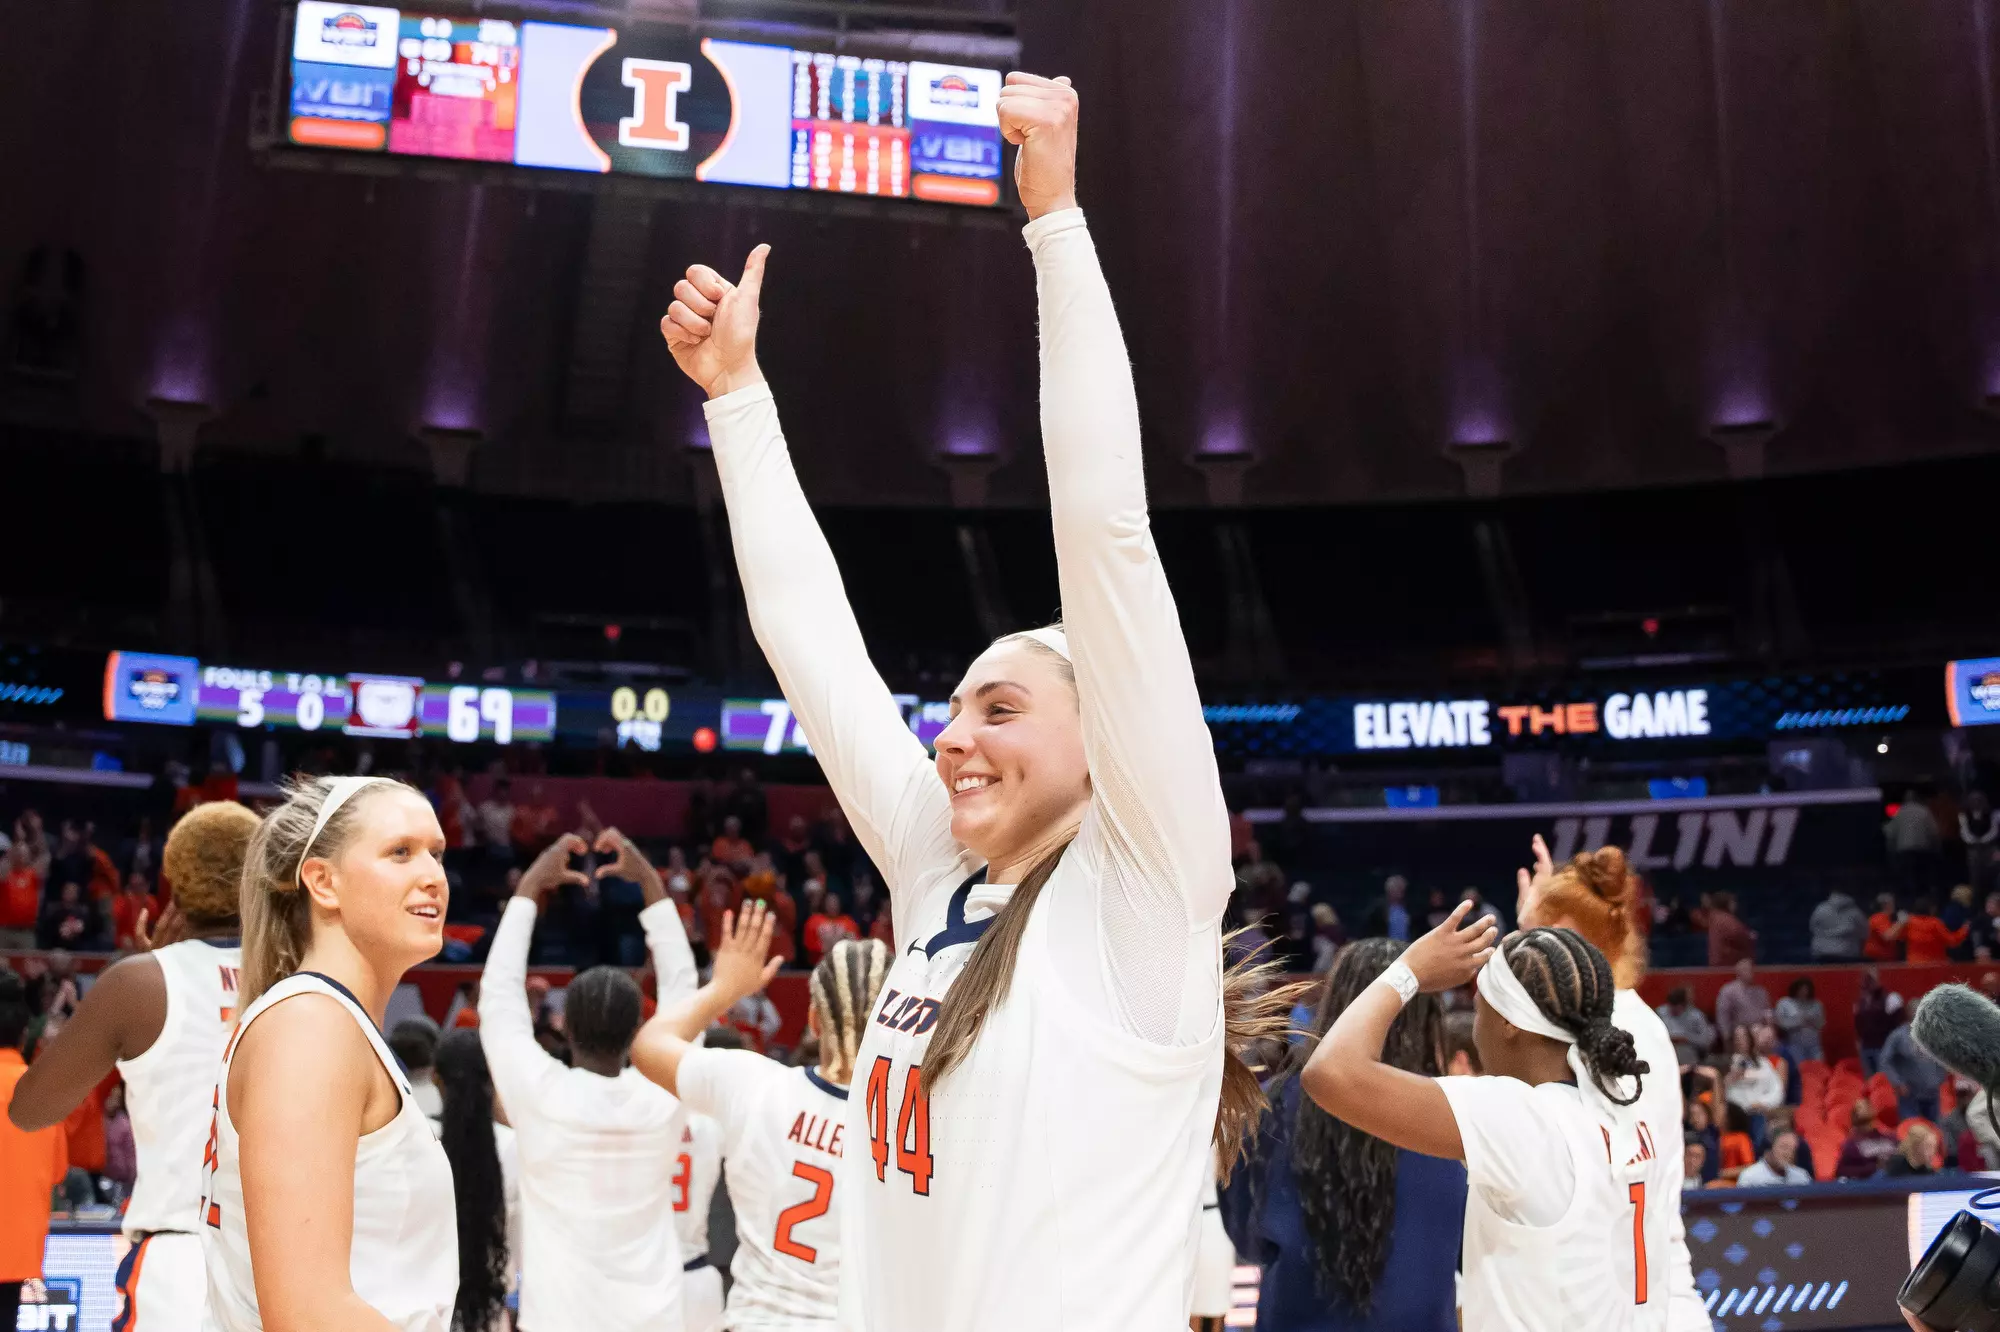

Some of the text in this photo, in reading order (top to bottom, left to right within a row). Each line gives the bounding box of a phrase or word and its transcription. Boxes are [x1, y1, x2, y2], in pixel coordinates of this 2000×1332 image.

[619, 57, 691, 151] I
[203, 666, 273, 693] FOULS
[612, 687, 669, 722] 0.0
[237, 688, 324, 731] 5 0
[447, 686, 513, 745] 69
[760, 699, 816, 757] 7
[1353, 689, 1711, 749] ELEVATE THE GAME
[788, 1110, 845, 1158] ALLE
[866, 1055, 934, 1197] 44
[774, 1160, 834, 1264] 2
[1628, 1181, 1648, 1306] 1
